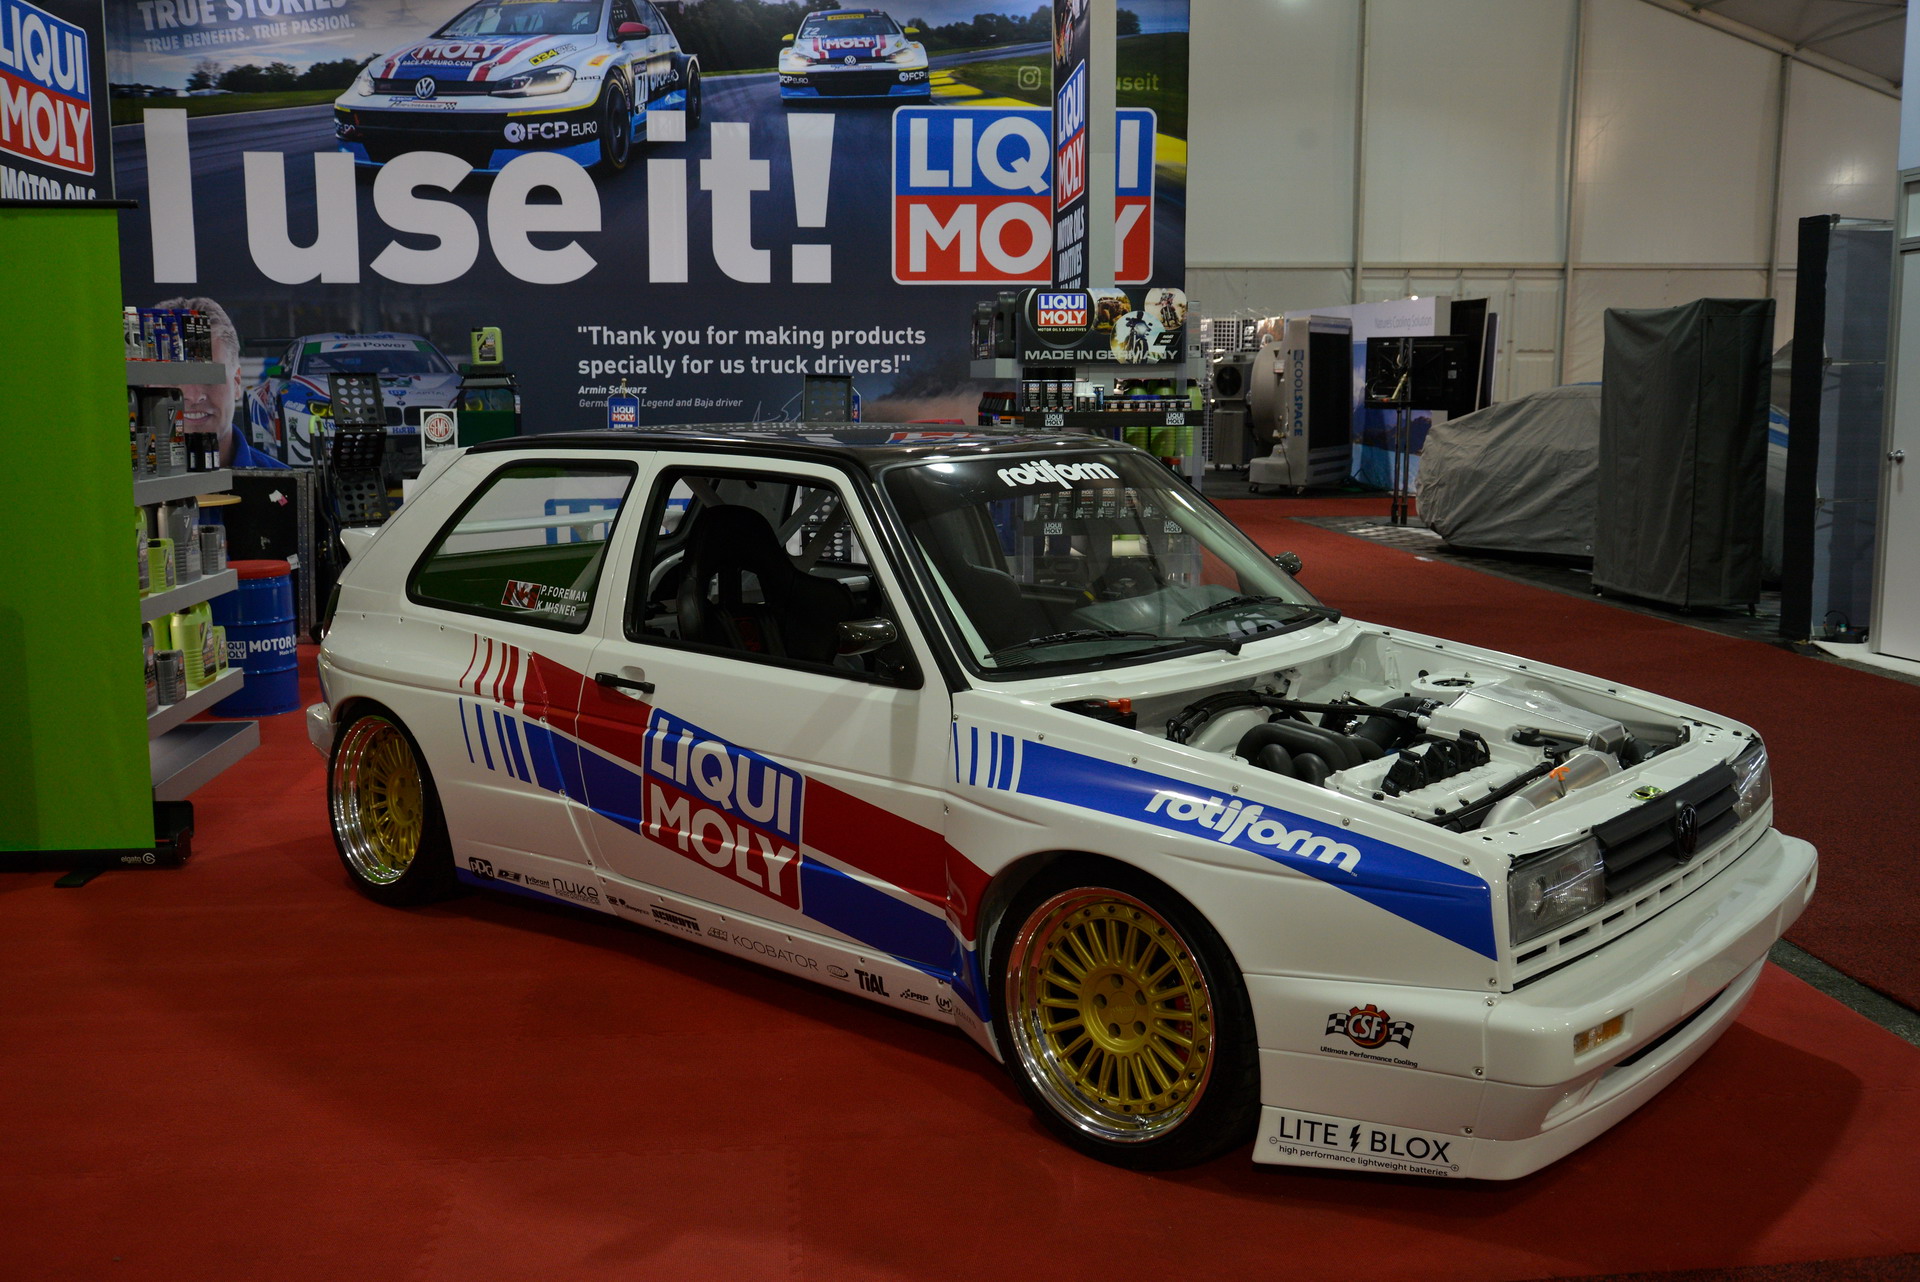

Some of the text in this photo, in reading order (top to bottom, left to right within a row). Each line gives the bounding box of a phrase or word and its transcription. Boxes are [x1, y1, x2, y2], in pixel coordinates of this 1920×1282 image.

[137, 1, 218, 31] TRUE
[144, 14, 356, 52] TRUE BENEFITS. TRUE PASSION.
[825, 38, 873, 49] MOLY
[1058, 65, 1084, 140] LIQUI
[0, 76, 90, 165] MOLY
[527, 120, 598, 140] FCP EURO
[909, 116, 1141, 194] LIQI
[1058, 133, 1085, 203] MOLY
[143, 107, 837, 286] I use it!
[909, 202, 1147, 274] MOY
[1057, 205, 1085, 251] MOTOR OILS
[1040, 295, 1084, 309] LIQUI
[1040, 310, 1085, 324] MOLY
[362, 341, 407, 349] Power
[577, 325, 926, 349] "Thank you for making products
[578, 355, 911, 378] specially for us truck drivers!"
[1025, 350, 1178, 360] MADE IN GERMANY
[578, 385, 607, 395] Armin
[612, 406, 635, 415] LIQUI
[641, 398, 673, 409] Legend
[675, 397, 692, 407] and
[694, 398, 713, 409] Baja
[716, 398, 743, 407] driver
[612, 413, 635, 422] MOLY
[996, 459, 1120, 490] rotiform
[1044, 527, 1063, 535] MOLY
[540, 585, 588, 602] P.FOREMAN
[536, 600, 577, 617] K.MISNER
[249, 636, 292, 654] MOTOR
[650, 716, 794, 835] LIQUI
[650, 782, 797, 897] MOLY
[1143, 789, 1362, 874] rotiform
[121, 855, 142, 864] elgato
[552, 878, 599, 900] nuke
[732, 933, 819, 971] KOOBATOR
[910, 991, 929, 1002] PRP
[1348, 1013, 1382, 1041] CSF
[1320, 1046, 1418, 1068] Ultimate Performance Cooling
[1279, 1116, 1451, 1164] LITE BLOX
[1279, 1144, 1448, 1178] high performance lightweight batteries
